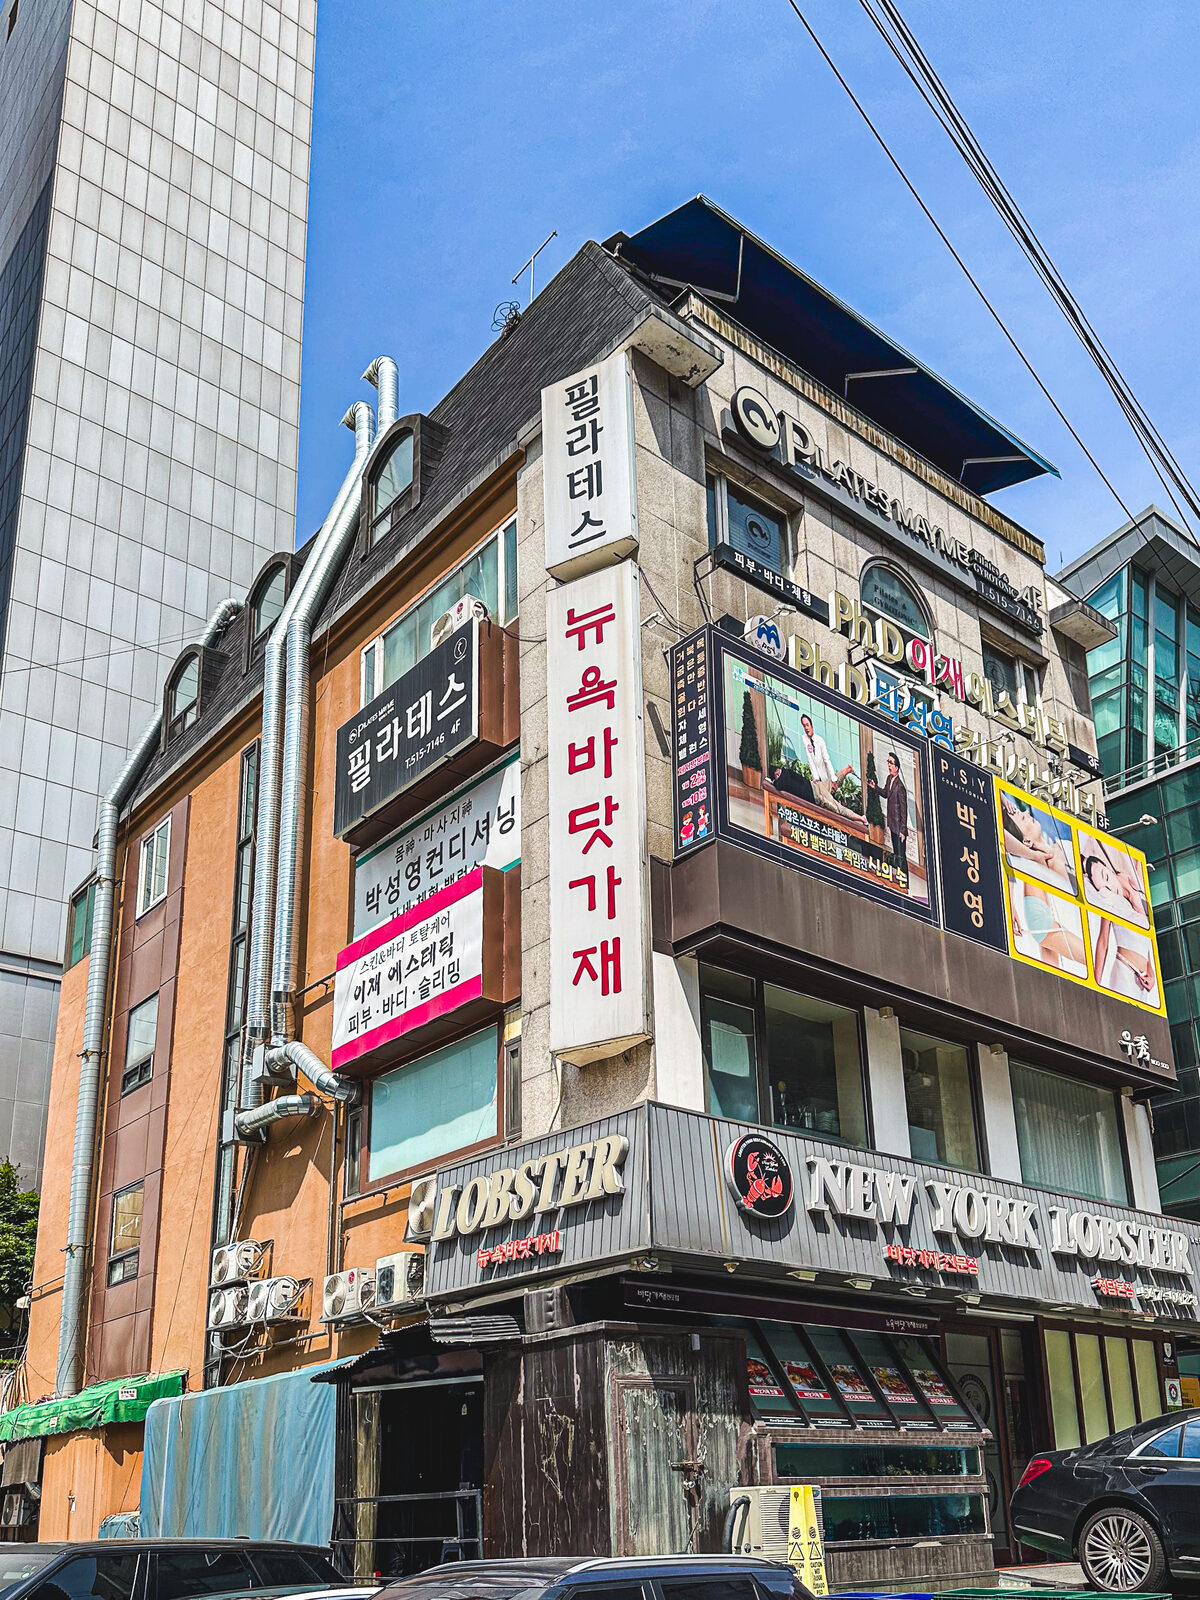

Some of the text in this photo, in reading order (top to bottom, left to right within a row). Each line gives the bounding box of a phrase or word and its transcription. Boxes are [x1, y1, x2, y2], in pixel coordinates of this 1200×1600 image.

[564, 374, 607, 549] 필라테스
[780, 410, 969, 568] PILATES MAYME
[973, 551, 1000, 577] Pilates
[973, 563, 1017, 598] GYROTONIC
[1021, 586, 1042, 613] 4F
[347, 673, 468, 793] 필라테스
[450, 718, 461, 735] 4F
[941, 777, 987, 804] CONDITIONING
[1087, 755, 1100, 770] 3F
[565, 602, 622, 997] 뉴욕바닷가재
[777, 805, 800, 824] 수많은
[799, 817, 820, 834] 스포츠
[1097, 814, 1110, 829] 3F
[790, 826, 810, 848] 체형
[868, 855, 893, 883] 신의
[955, 800, 984, 928] 박성영
[353, 931, 454, 1004] 이재 에스테틱
[359, 910, 451, 975] 스킨&바디 토탈케어
[348, 958, 460, 1034] 피부·바디·슬리밍
[430, 1133, 630, 1243] LOBSTER
[806, 1154, 1194, 1276] NEW YORK LOBSTER
[476, 1230, 561, 1268] 뉴욕바닷가재
[1095, 1277, 1135, 1299] 청담본점
